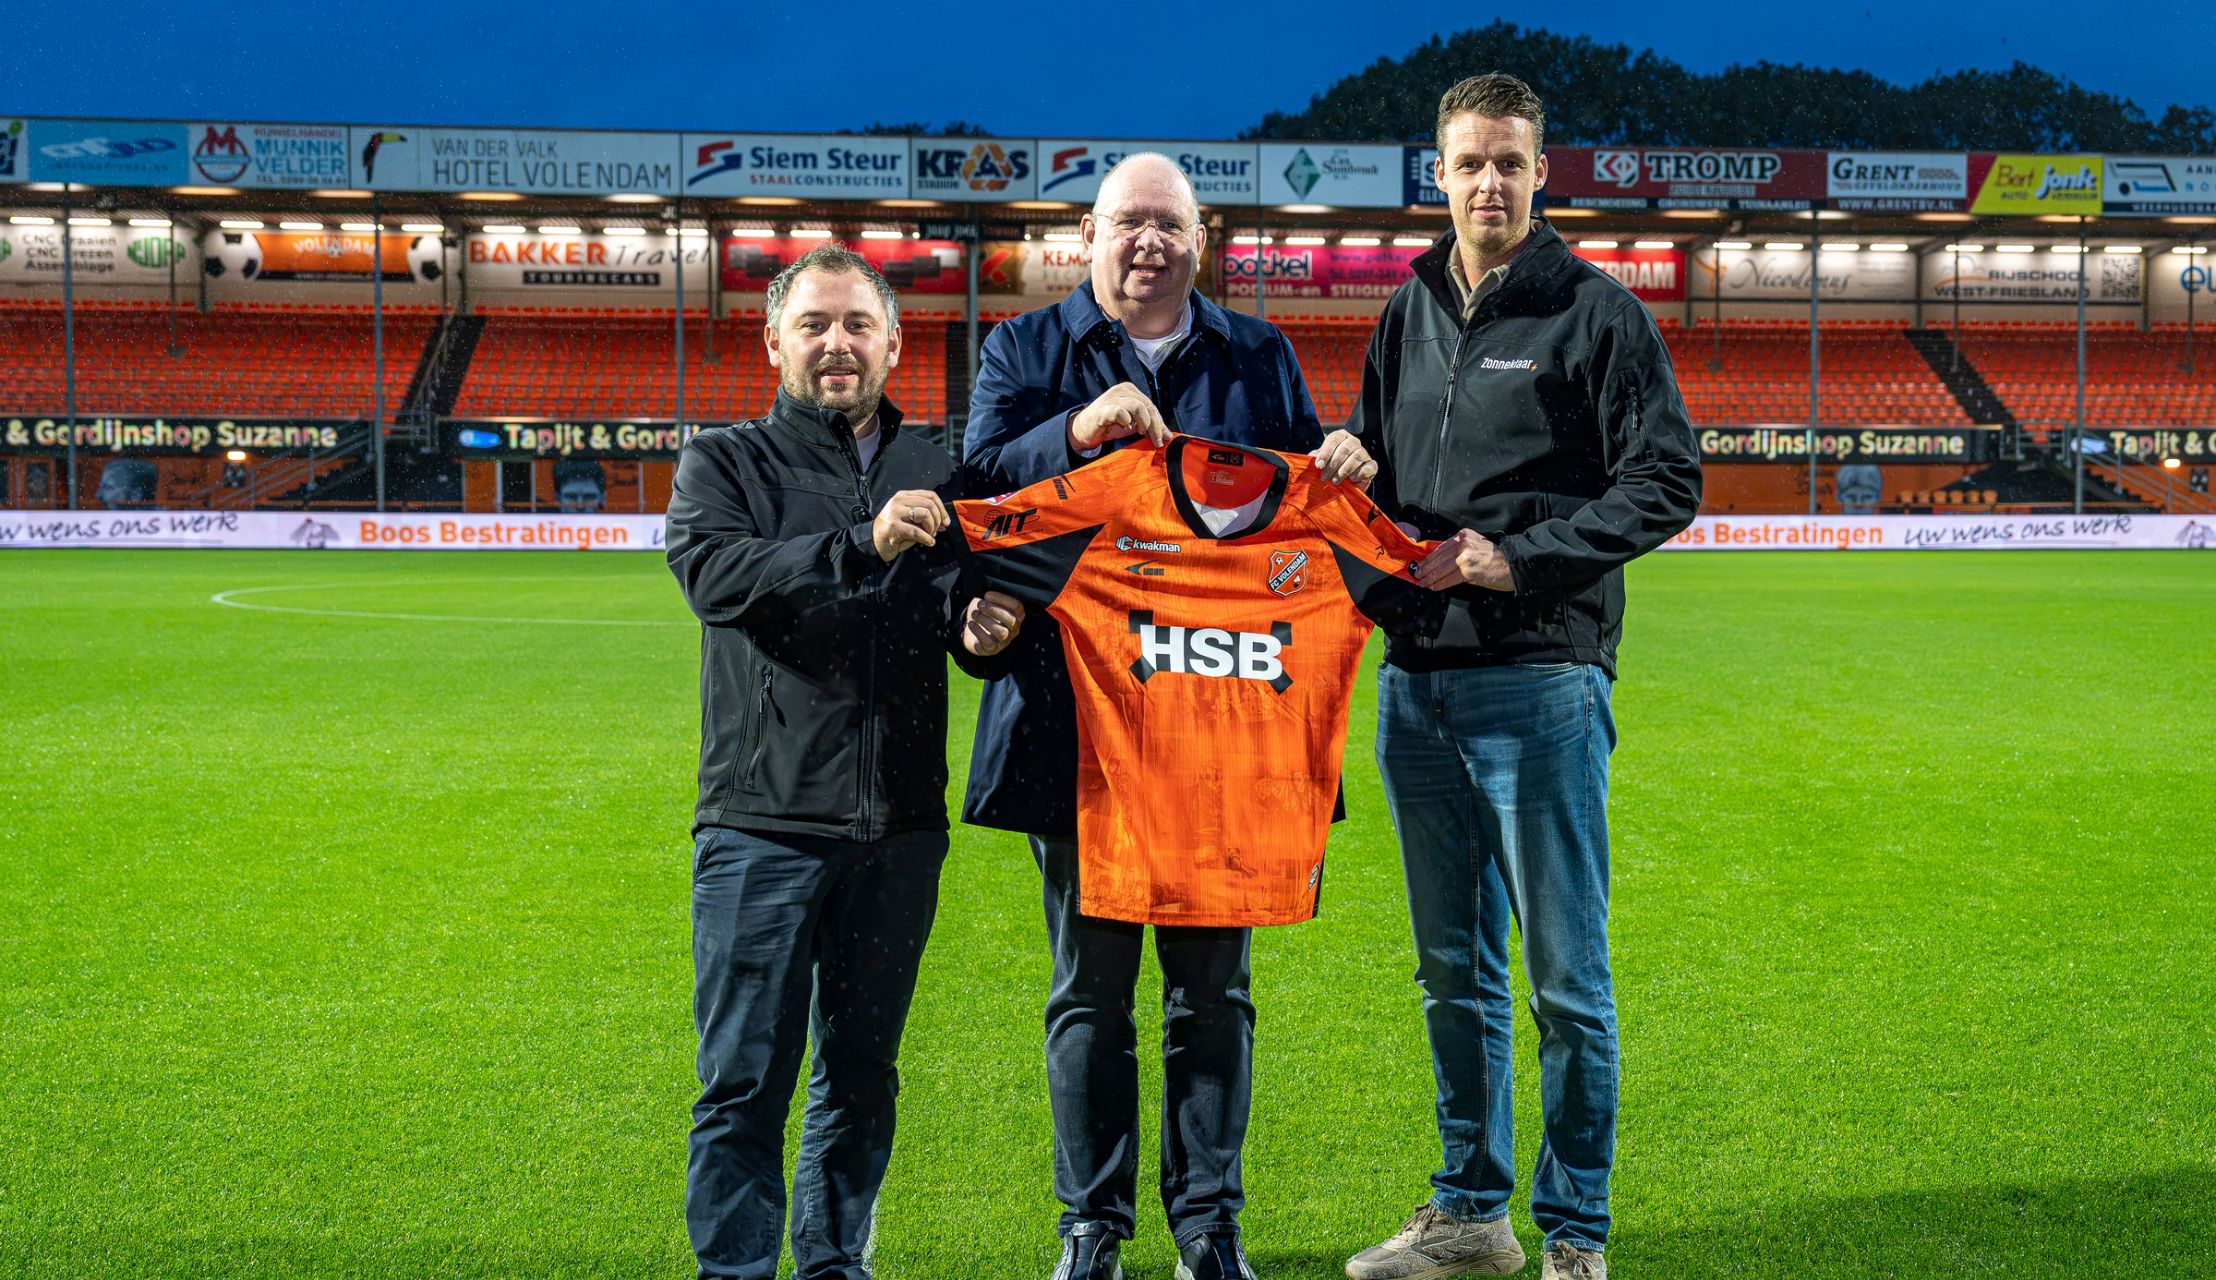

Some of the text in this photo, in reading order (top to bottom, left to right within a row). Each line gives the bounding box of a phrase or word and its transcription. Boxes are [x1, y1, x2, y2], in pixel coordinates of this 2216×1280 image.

[255, 140, 344, 155] MUNNIK
[433, 138, 558, 158] VAN DER VALK
[751, 147, 902, 170] Siem Steur
[255, 157, 345, 174] VELDER
[433, 160, 671, 189] HOTEL VOLENDAM
[1645, 152, 1781, 182] TROMP
[1833, 157, 1915, 181] GRENT
[750, 175, 903, 187] STAALCONSTRUCTIES
[22, 235, 55, 245] CNC
[26, 247, 59, 258] CNC
[468, 240, 608, 265] BAKKER
[1481, 357, 1534, 370] Zonneklaar
[6, 419, 30, 446] &
[216, 420, 338, 447] Suzanne
[504, 424, 584, 455] Tapijt
[590, 424, 612, 450] &
[1859, 430, 1965, 456] Suzanne
[2109, 431, 2180, 461] Tapijt
[2184, 431, 2203, 455] &
[28, 519, 100, 541] wens
[108, 516, 160, 536] ons
[170, 511, 239, 533] werk
[360, 519, 431, 543] Boos
[439, 520, 628, 550] Bestratingen
[982, 507, 1038, 541] AIT
[1714, 523, 1883, 550] Bestratingen
[1952, 523, 2014, 543] wens
[2021, 521, 2064, 538] ons
[2073, 514, 2133, 534] werk
[1132, 539, 1181, 552] kwakman
[1270, 552, 1307, 590] FC VOLENDAM
[1140, 624, 1283, 681] HSB
